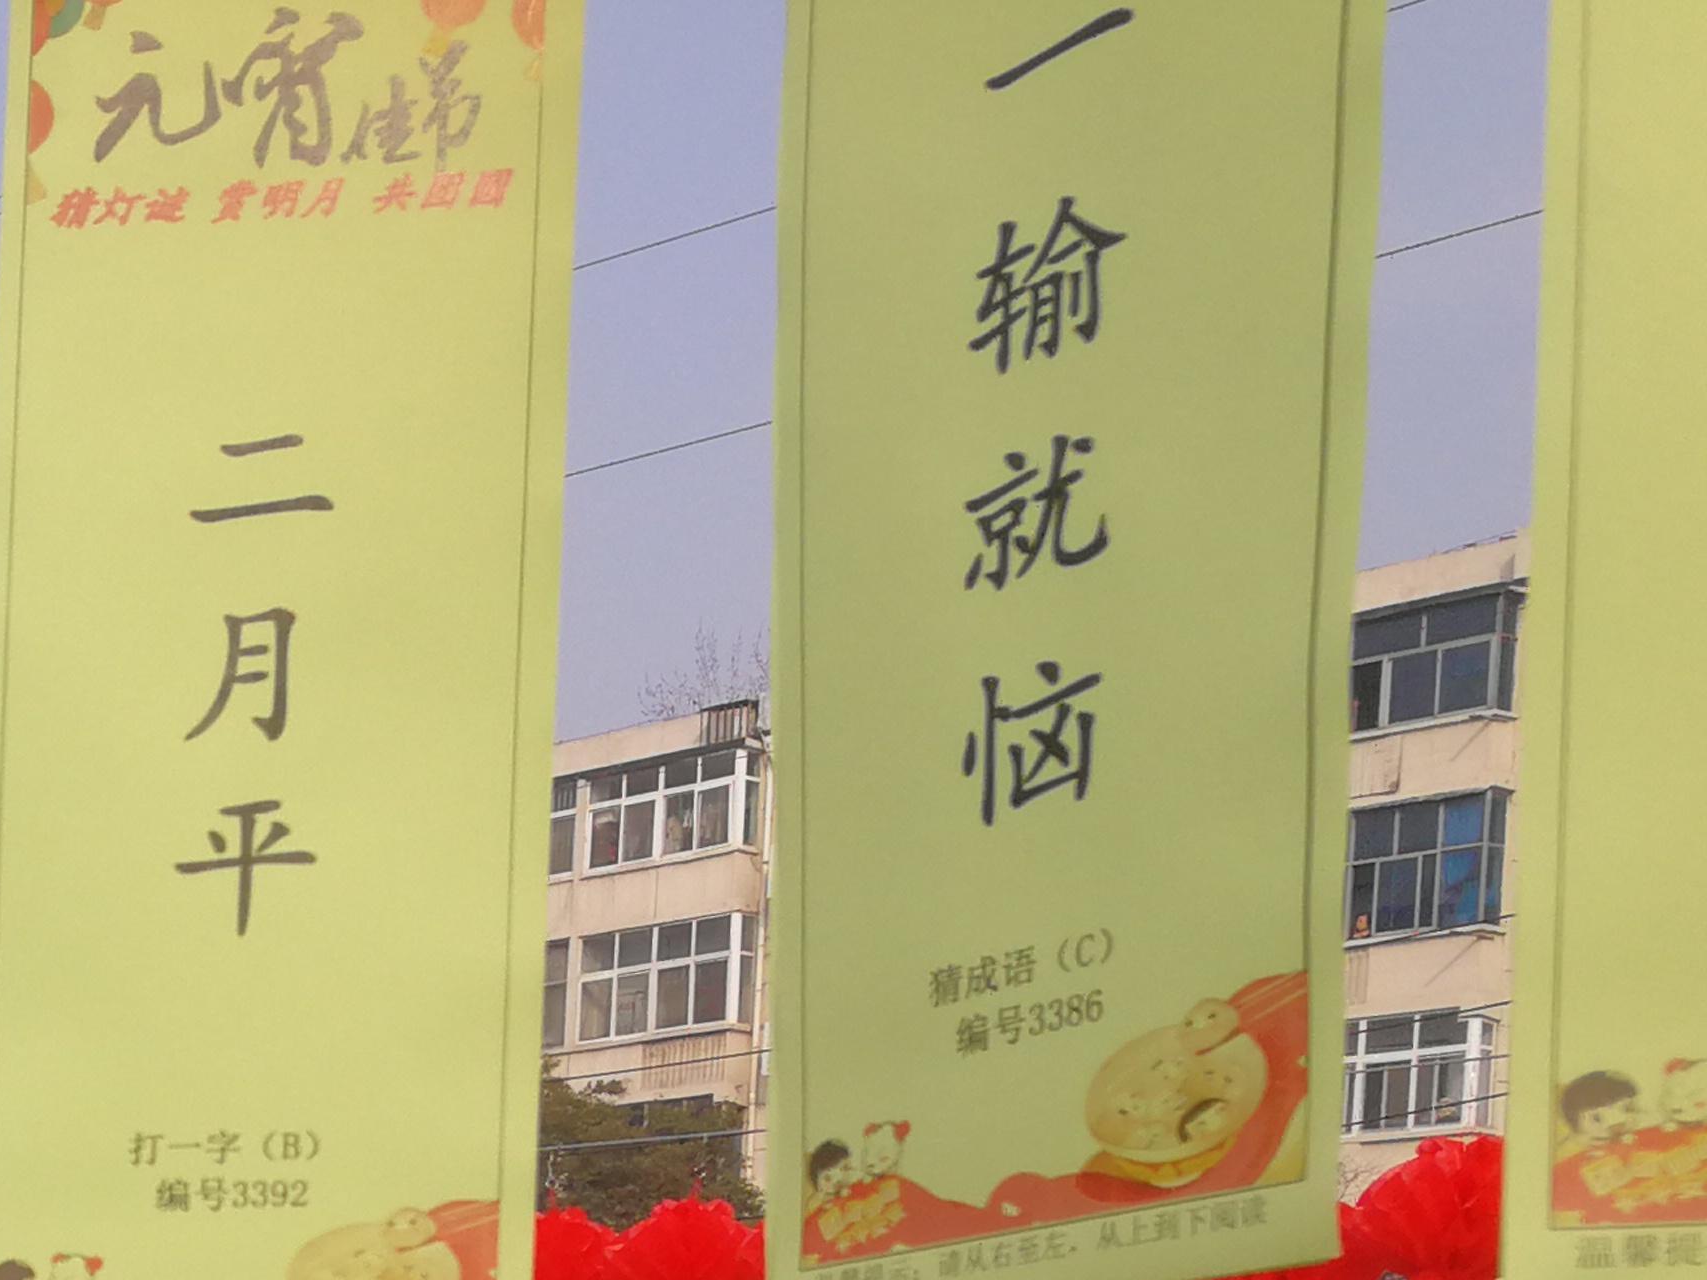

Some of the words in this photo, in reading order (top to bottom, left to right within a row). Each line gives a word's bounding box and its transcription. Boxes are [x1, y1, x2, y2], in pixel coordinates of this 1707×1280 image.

[962, 8, 1134, 827] 一输就恼
[174, 433, 335, 937] 二月平
[955, 989, 1105, 1056] 编号3386
[157, 1177, 309, 1212] 编号3392
